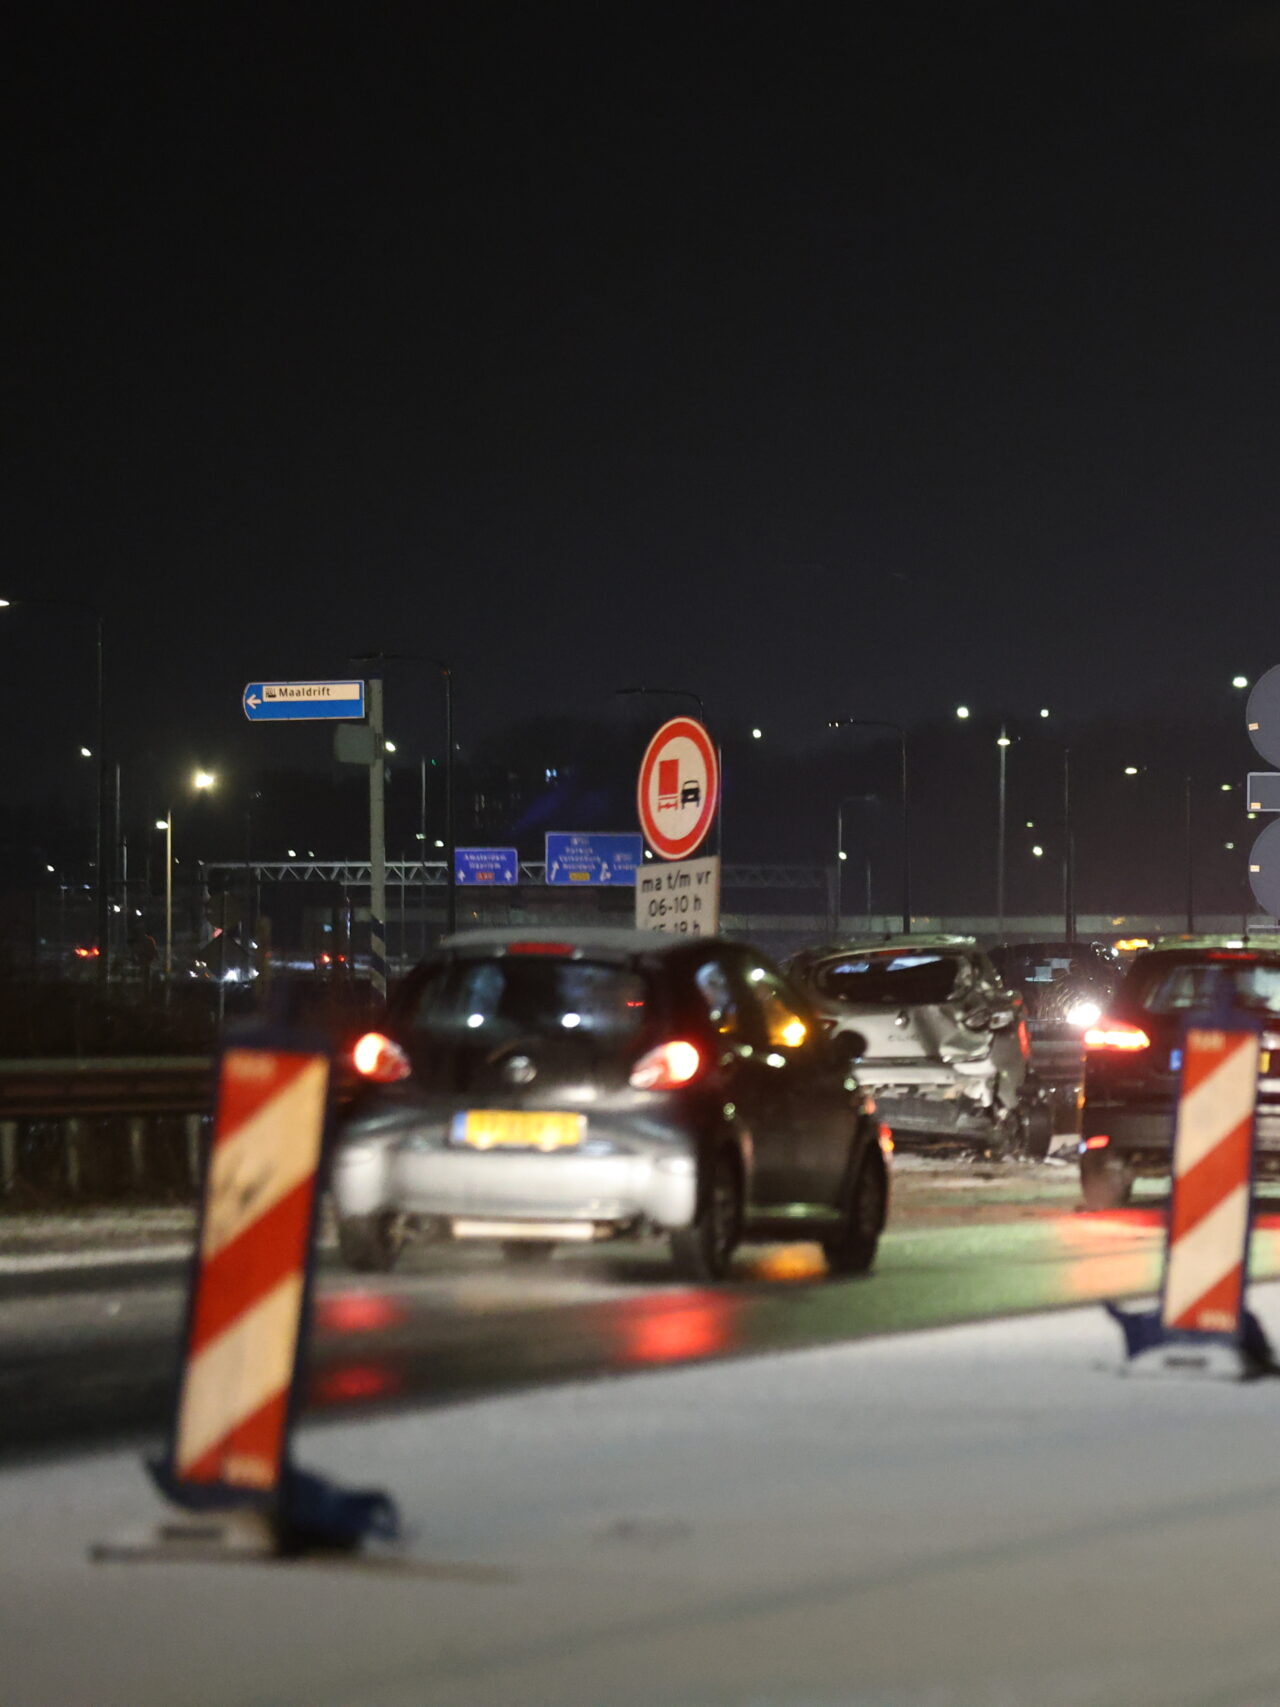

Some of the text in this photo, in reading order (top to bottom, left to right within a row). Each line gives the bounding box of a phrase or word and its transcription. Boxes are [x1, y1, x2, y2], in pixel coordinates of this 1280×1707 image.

[279, 686, 331, 698] Maaldrift
[641, 869, 711, 893] ma t/m vr
[648, 895, 702, 917] 06-10 h
